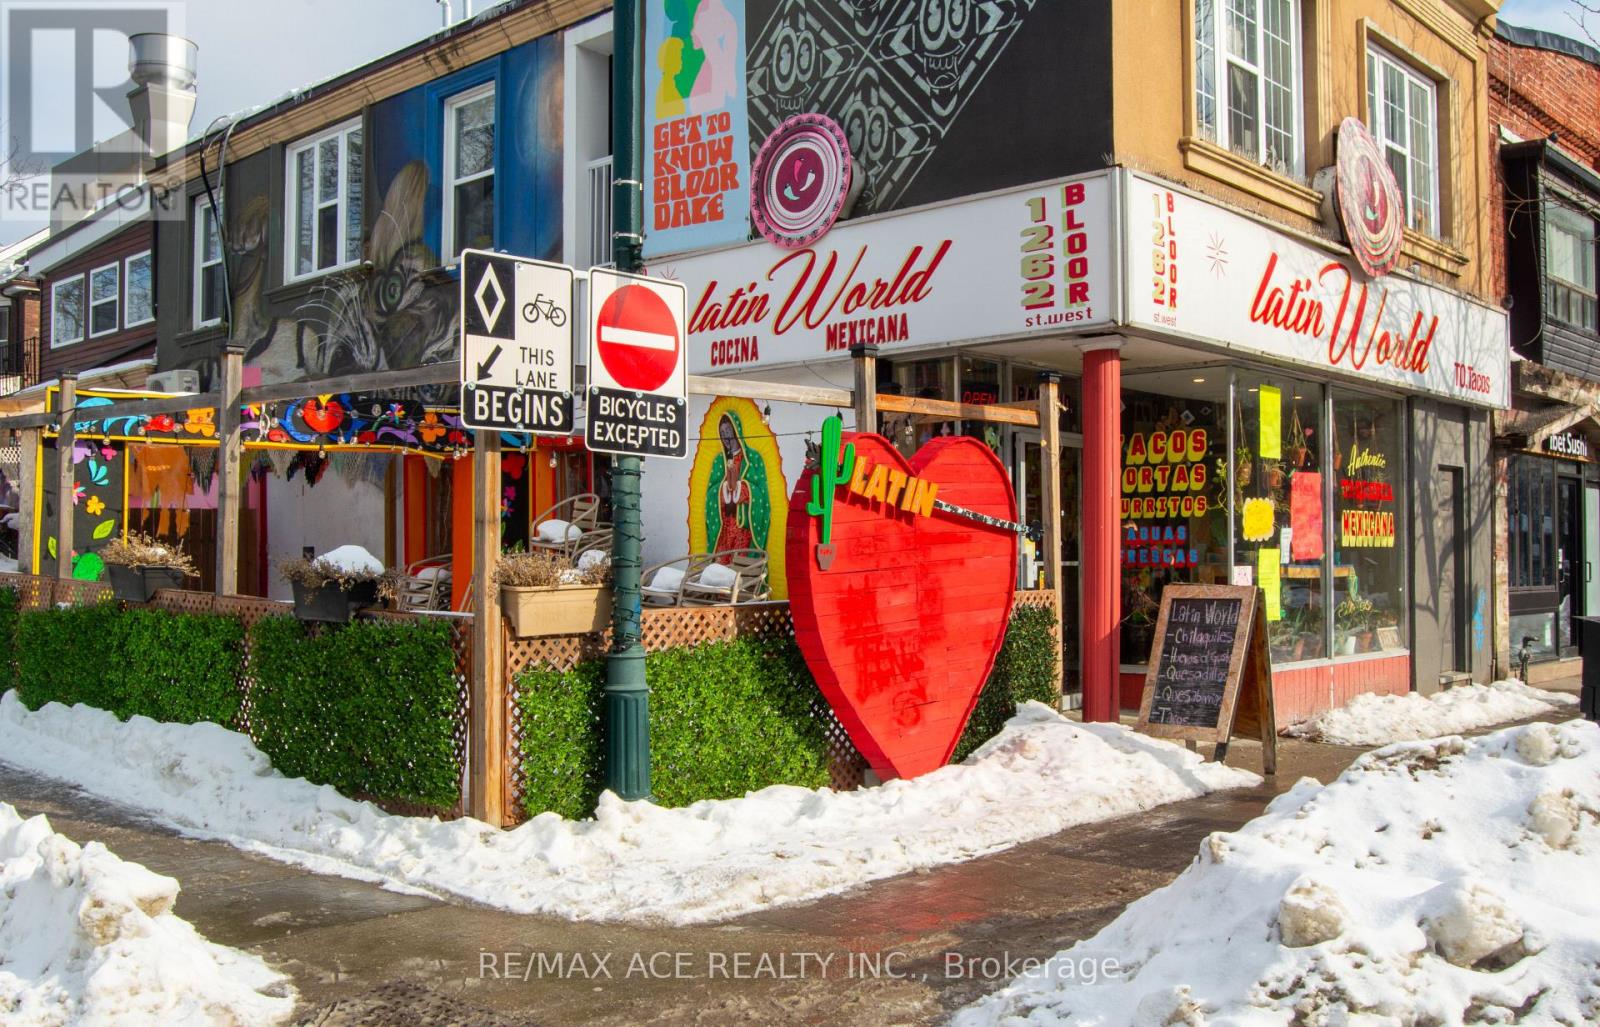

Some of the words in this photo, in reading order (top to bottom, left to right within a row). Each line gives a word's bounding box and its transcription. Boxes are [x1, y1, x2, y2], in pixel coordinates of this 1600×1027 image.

[654, 114, 702, 150] GET
[706, 111, 731, 136] TO
[654, 135, 734, 177] KNOW
[654, 162, 740, 204] BLOOR
[654, 193, 724, 231] DALE
[1020, 194, 1054, 311] 1262
[1061, 182, 1089, 309] BLOOR
[1166, 191, 1177, 308] BLOOR
[768, 239, 952, 336] World
[1318, 261, 1439, 374] World
[519, 346, 554, 366] THIS
[711, 335, 759, 366] COCINA
[825, 312, 909, 351] MEXICANA
[515, 368, 558, 389] LANE
[474, 389, 564, 426] BEGINS
[599, 395, 676, 424] BICYCLES
[963, 391, 997, 405] OPEN
[594, 420, 680, 449] EXCEPTED
[1566, 432, 1588, 456] Sushi
[850, 456, 939, 518] LATIN
[1122, 463, 1206, 493] ORTAS
[1120, 495, 1207, 519] URRITOS
[1341, 510, 1395, 547] MEXICANA
[1171, 601, 1201, 623] Latin
[1205, 601, 1241, 625] World
